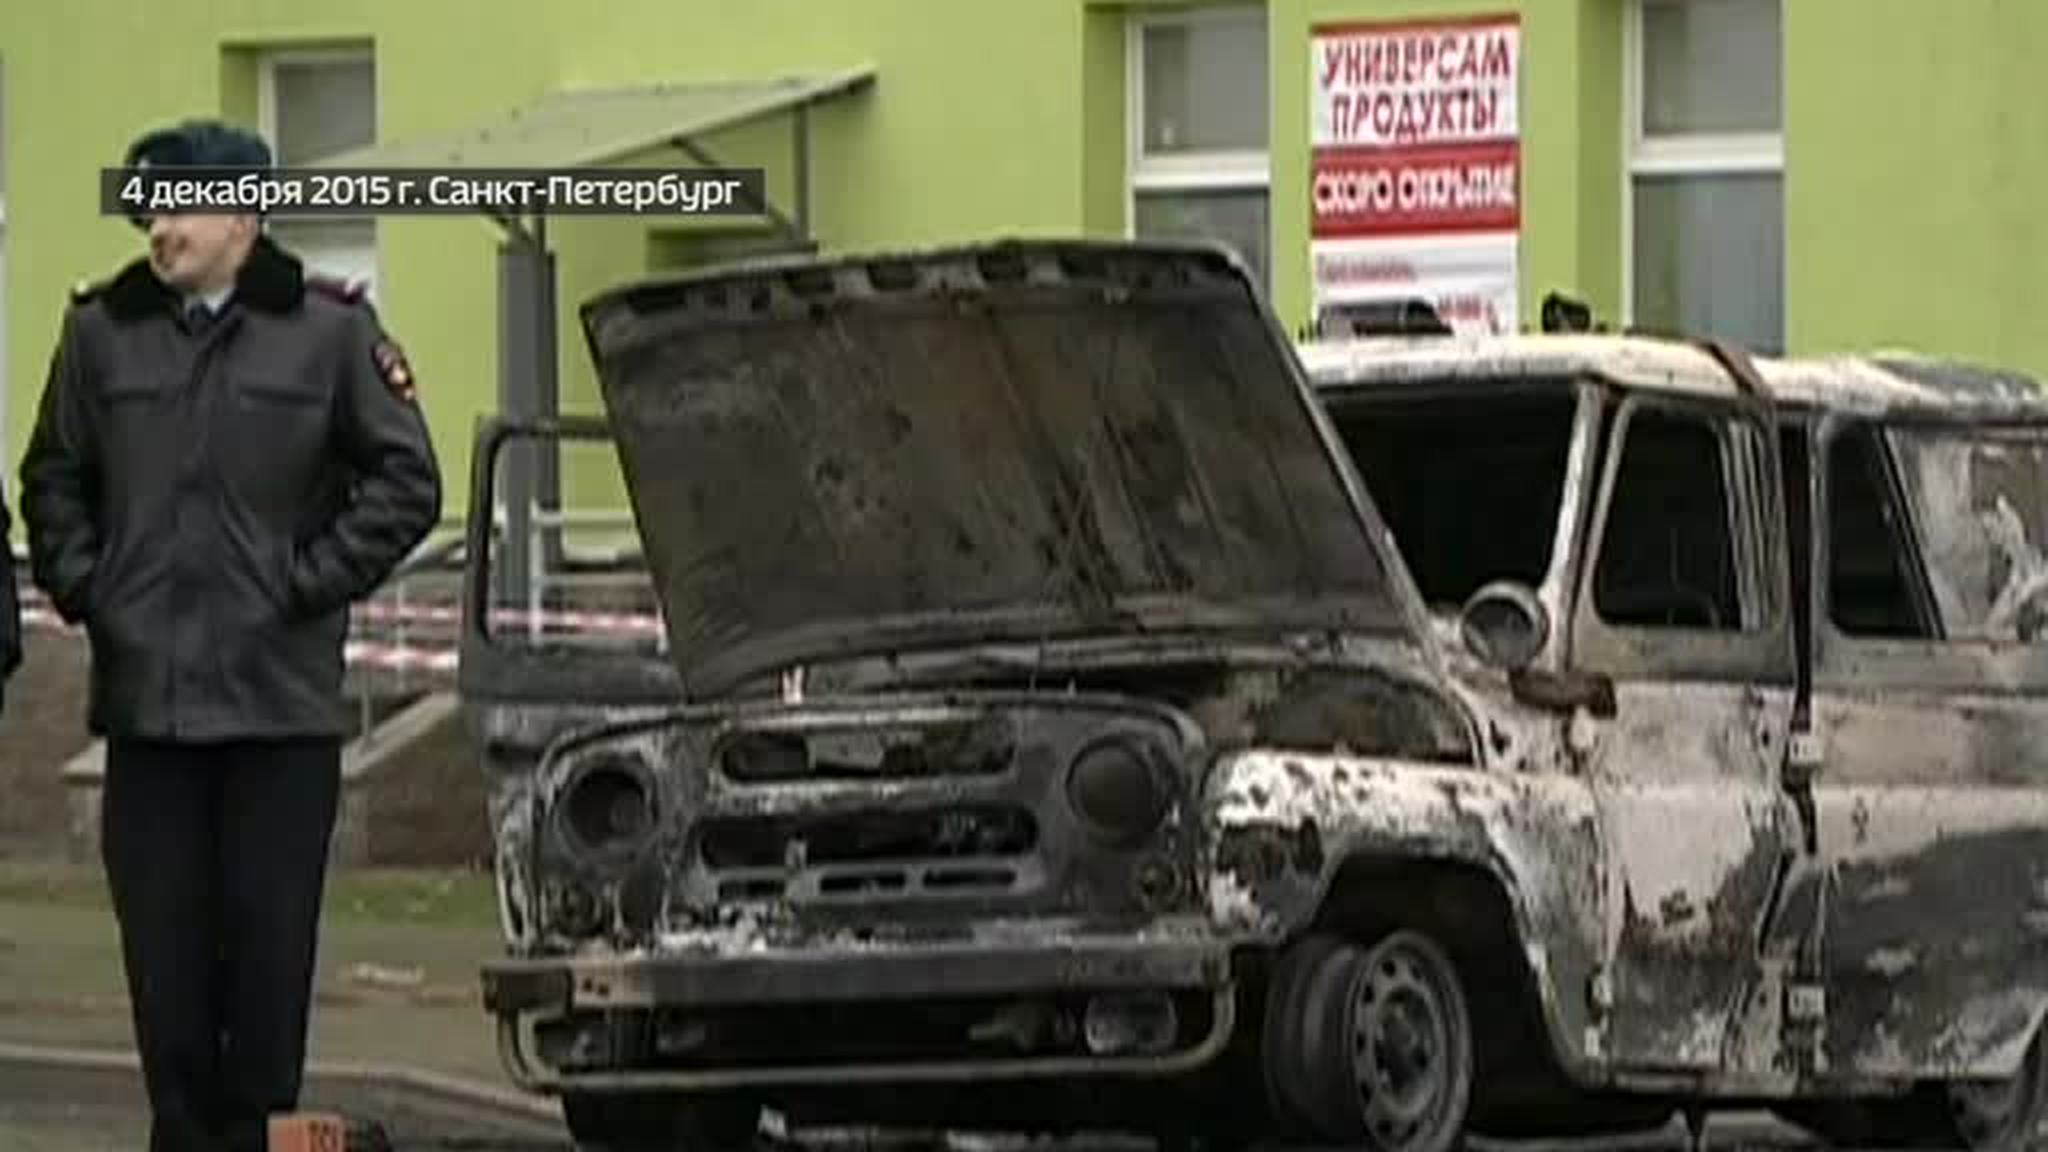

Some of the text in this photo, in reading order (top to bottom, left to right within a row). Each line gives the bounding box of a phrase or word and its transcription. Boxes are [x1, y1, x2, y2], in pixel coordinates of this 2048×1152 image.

[1321, 35, 1509, 87] УНИВЕРСАМ
[1332, 86, 1499, 140] ПРОДУКТЫ
[1313, 169, 1394, 214] СКОРО
